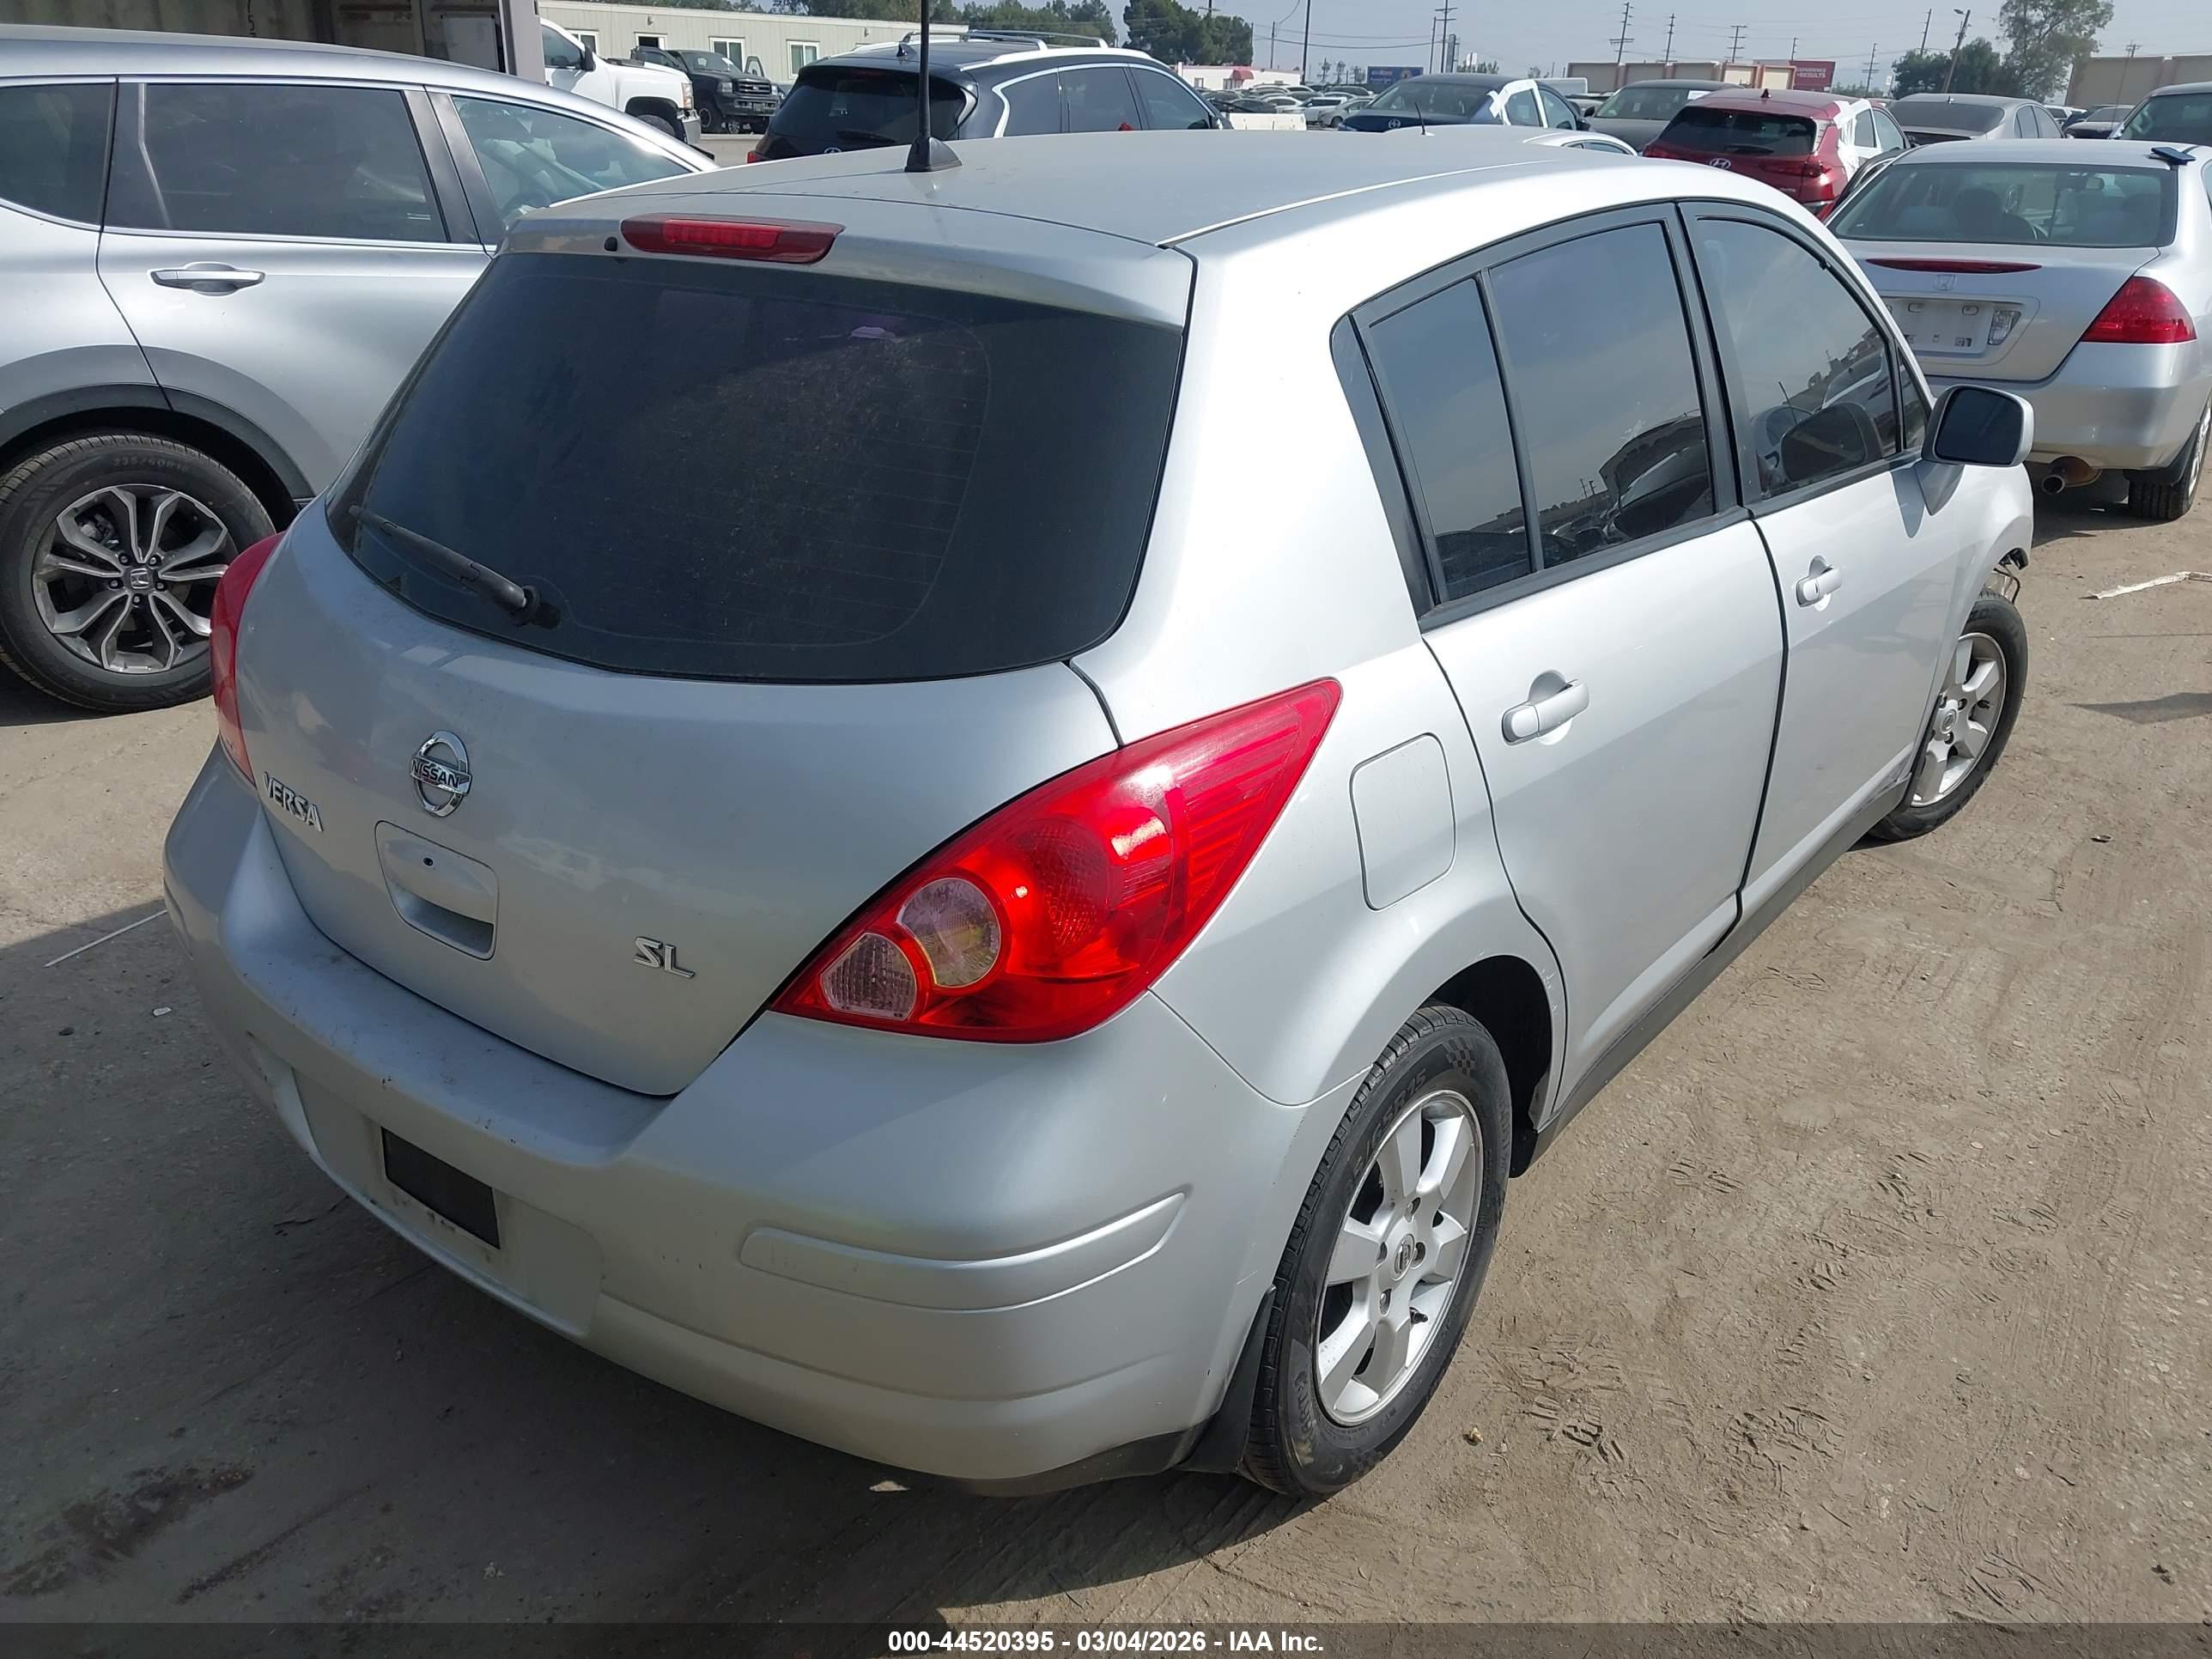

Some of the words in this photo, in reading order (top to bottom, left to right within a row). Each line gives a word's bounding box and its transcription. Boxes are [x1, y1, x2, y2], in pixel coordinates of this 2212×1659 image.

[412, 758, 459, 788] NISSAN
[262, 771, 324, 832] VERSA
[634, 936, 696, 979] SL
